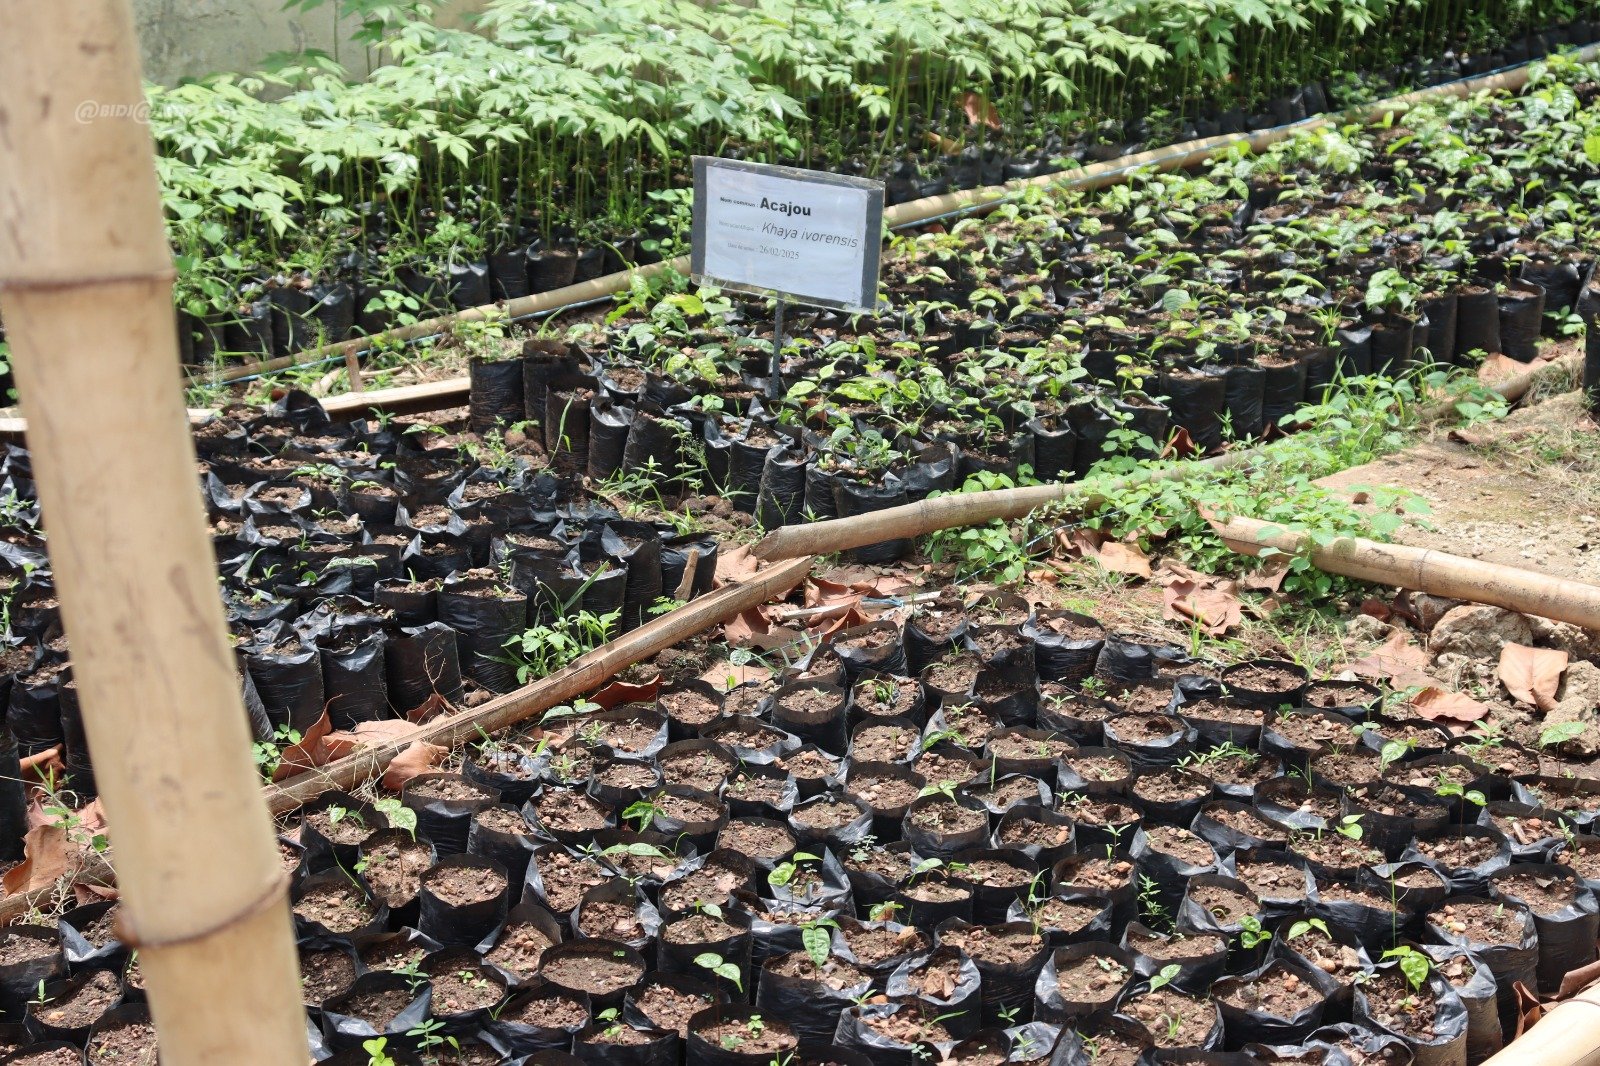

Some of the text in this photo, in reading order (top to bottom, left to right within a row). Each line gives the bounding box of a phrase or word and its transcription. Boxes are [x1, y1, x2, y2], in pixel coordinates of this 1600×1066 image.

[760, 197, 811, 216] Acajou
[761, 221, 798, 240] Khaya
[801, 228, 858, 248] ivorensis
[759, 245, 800, 260] 26/02/2025
